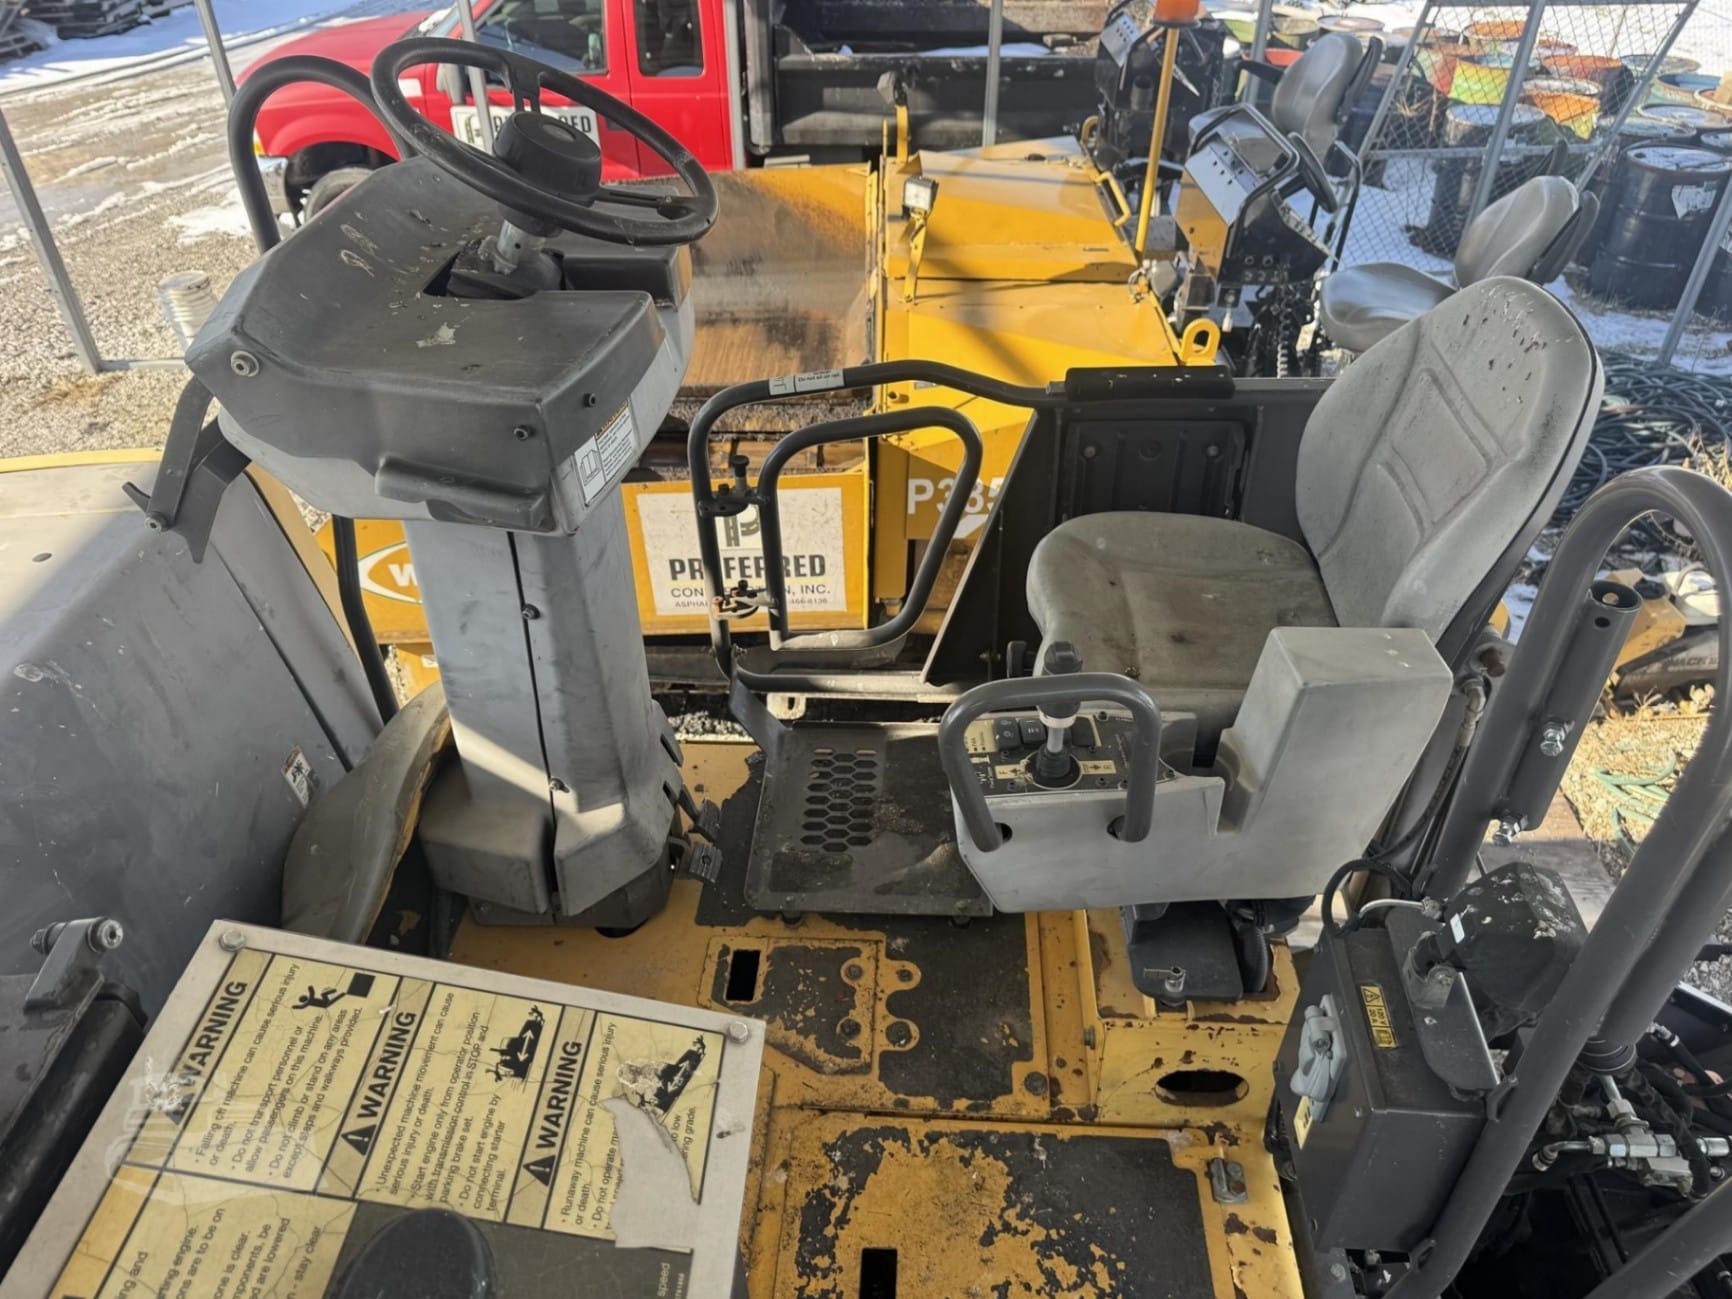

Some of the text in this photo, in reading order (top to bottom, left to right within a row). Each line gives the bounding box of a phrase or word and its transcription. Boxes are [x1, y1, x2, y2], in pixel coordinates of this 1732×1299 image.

[801, 584, 831, 594] INC.
[173, 980, 248, 1087] WARNING
[462, 1011, 480, 1045] position
[194, 1122, 222, 1156] Falling
[221, 1065, 248, 1105] machine
[243, 1047, 257, 1063] can
[252, 1018, 271, 1044] cause
[265, 986, 287, 1017] serious
[281, 963, 300, 985] injury
[356, 1011, 416, 1119] WARNING
[448, 1046, 469, 1084] operator
[231, 1147, 246, 1162] Do
[240, 1128, 255, 1145] not
[248, 1082, 278, 1126] transport
[271, 1036, 299, 1081] personnel
[243, 1145, 263, 1171] allow
[257, 1087, 291, 1143] passengers
[289, 1054, 304, 1070] this
[298, 1014, 323, 1052] machine.
[268, 1153, 283, 1168] Do
[277, 1134, 291, 1151] not
[304, 1065, 322, 1091] stand
[323, 1034, 338, 1051] any
[331, 1008, 347, 1032] areas
[282, 1007, 364, 1178] except steps and walkways provided.
[375, 1124, 407, 1185] Unexpected
[399, 1083, 421, 1123] machine
[415, 1035, 438, 1081] movement
[439, 992, 454, 1017] cause
[439, 1086, 454, 1106] from
[535, 1040, 581, 1149] WARNING
[424, 1178, 438, 1200] with
[431, 1114, 459, 1176] transmission
[452, 1080, 471, 1113] control
[466, 1043, 482, 1070] STOP
[433, 1108, 448, 1129] only
[560, 1169, 582, 1216] Runaway
[572, 1126, 590, 1167] machine
[588, 1078, 601, 1106] cause
[595, 1046, 609, 1077] serious
[602, 1021, 617, 1045] injury
[684, 1106, 696, 1134] grade.
[388, 1157, 409, 1195] serious
[401, 1128, 421, 1156] injury
[421, 1130, 440, 1164] engine
[437, 1115, 473, 1203] parking brake set.
[458, 1184, 471, 1199] Do
[472, 1141, 485, 1163] start
[479, 1107, 496, 1139] engine
[472, 1119, 506, 1209] connecting starter
[601, 1146, 617, 1185] operate
[485, 1168, 506, 1211] terminal.
[201, 1224, 217, 1239] be
[211, 1208, 225, 1222] on
[257, 1223, 272, 1238] be
[171, 1224, 200, 1266] engine.
[195, 1241, 209, 1254] to
[229, 1229, 251, 1260] clear.
[262, 1217, 290, 1263] lowered
[127, 1250, 149, 1276] and
[186, 1257, 202, 1276] are
[255, 1265, 270, 1284] are
[293, 1256, 312, 1281] stay
